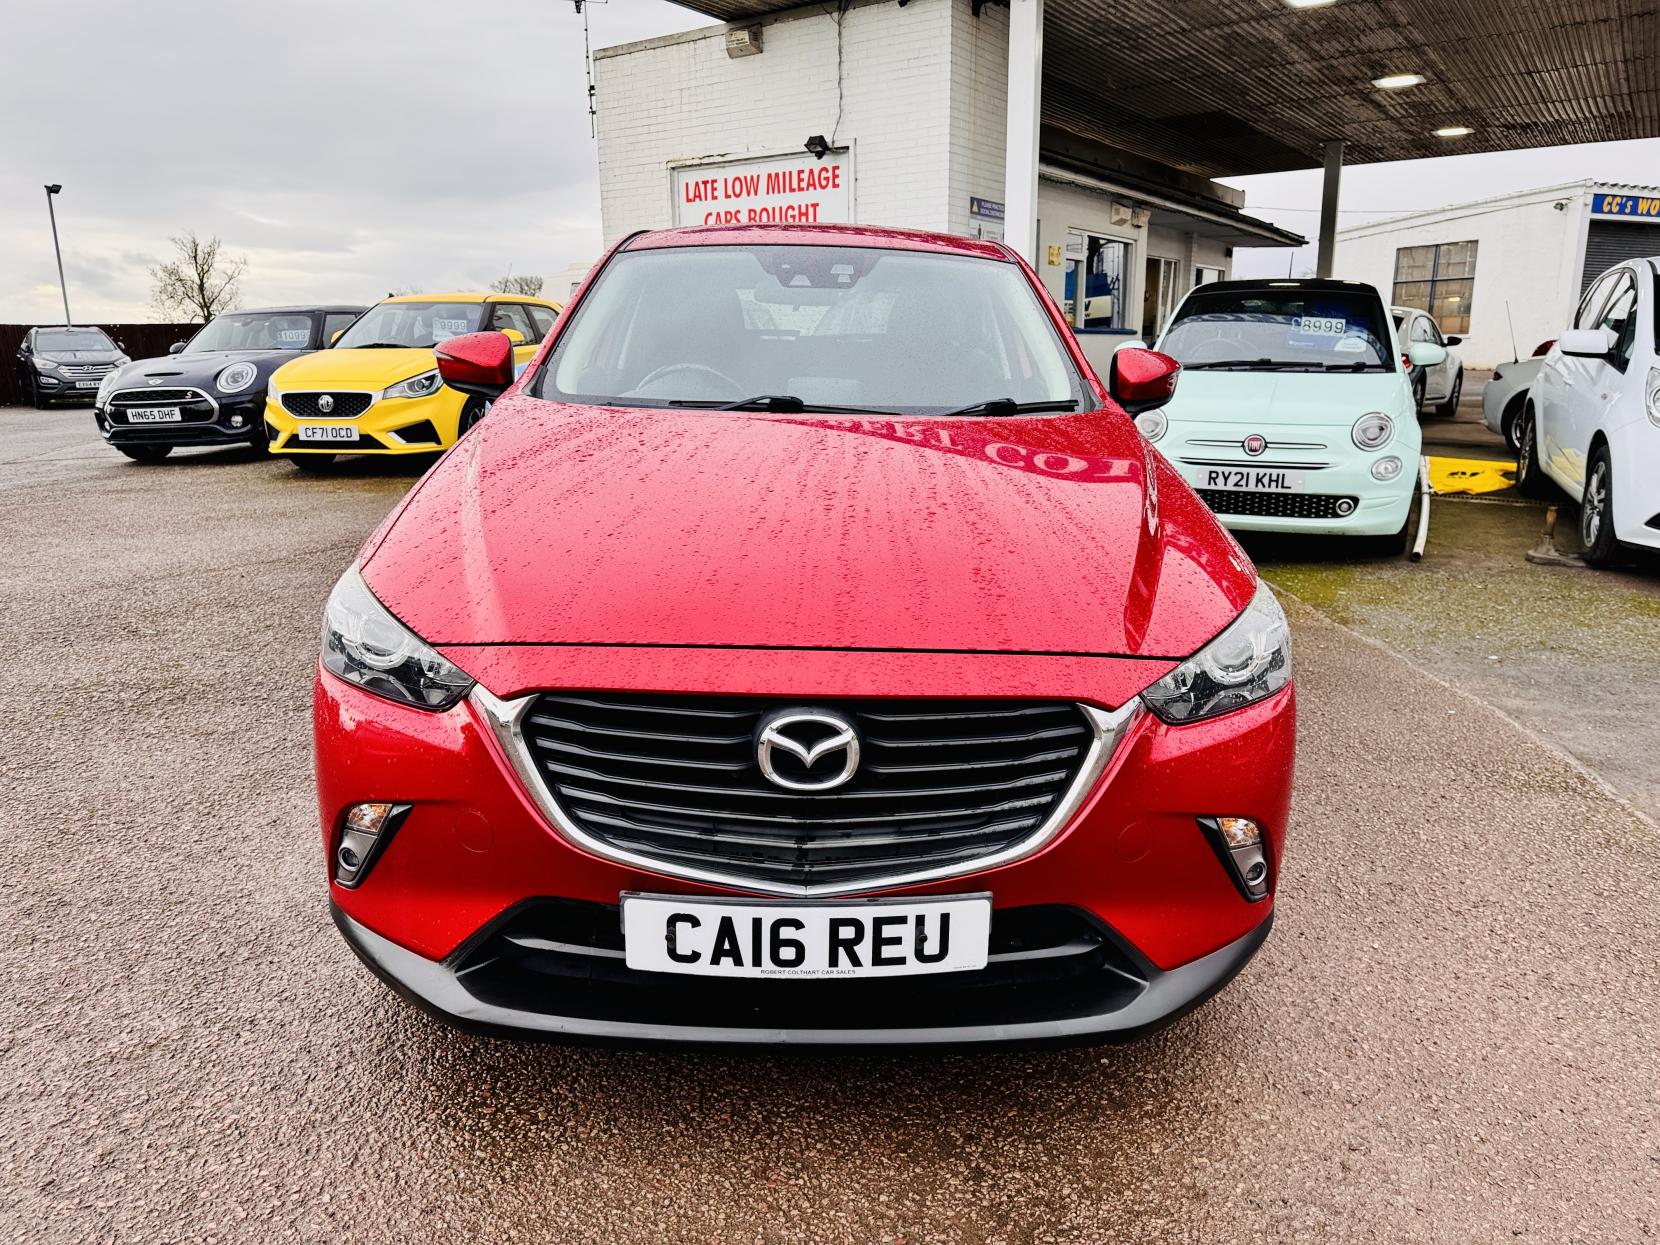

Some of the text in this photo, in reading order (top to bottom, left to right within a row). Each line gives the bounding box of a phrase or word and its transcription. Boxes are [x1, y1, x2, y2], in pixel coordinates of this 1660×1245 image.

[685, 165, 840, 203] LATE LOW MILEAGE
[704, 203, 819, 225] CARS BOUGHT
[1602, 195, 1660, 215] CC's WO
[131, 410, 176, 420] HN65 DHF
[305, 427, 353, 438] CF71 OCD
[1208, 470, 1292, 489] RY21 KHL
[665, 912, 951, 969] CA16 REU
